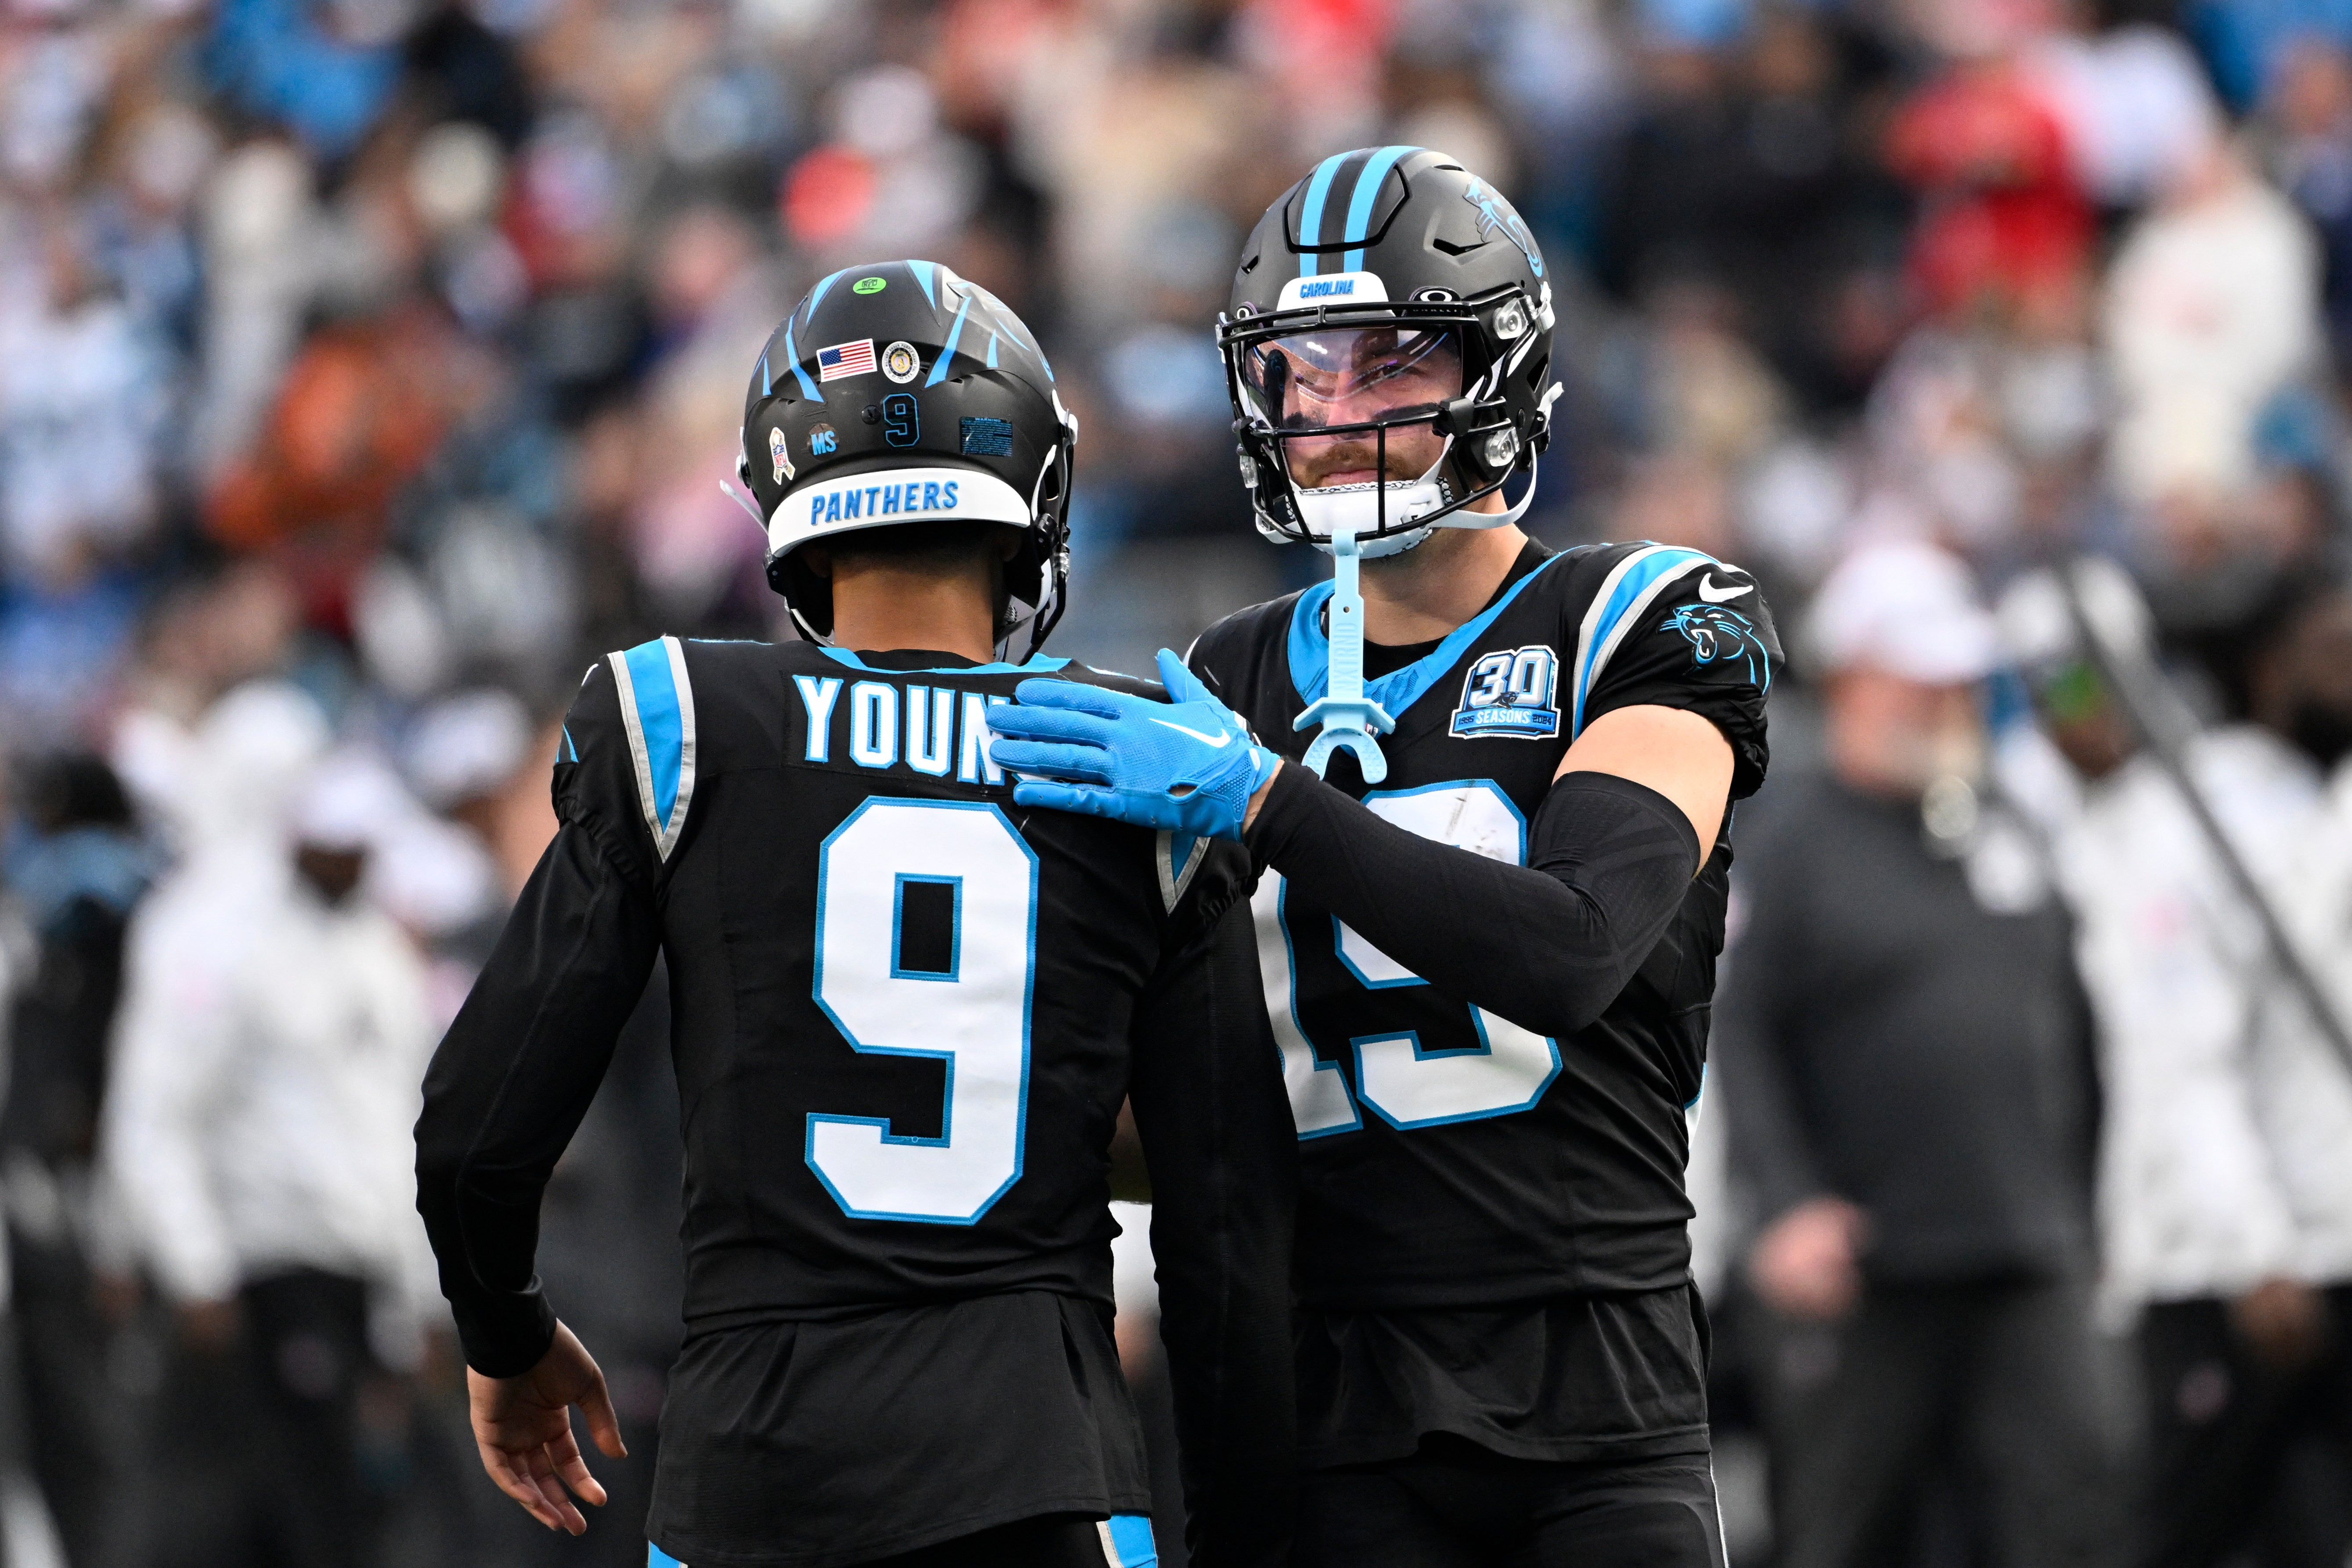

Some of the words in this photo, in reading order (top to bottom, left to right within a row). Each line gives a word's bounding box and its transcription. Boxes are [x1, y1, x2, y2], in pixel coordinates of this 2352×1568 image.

[1300, 280, 1354, 298] CAROLINA
[811, 431, 837, 456] MS
[882, 393, 919, 447] 9
[774, 453, 786, 467] NFL
[810, 480, 959, 526] PANTHERS
[1333, 622, 1358, 691] NXTRND
[1468, 648, 1551, 708] 30
[792, 674, 1054, 786] YOUN
[1458, 715, 1475, 725] 1995
[1476, 709, 1531, 724] SEASONS
[1532, 714, 1553, 726] 2024
[804, 795, 1040, 1226] 9
